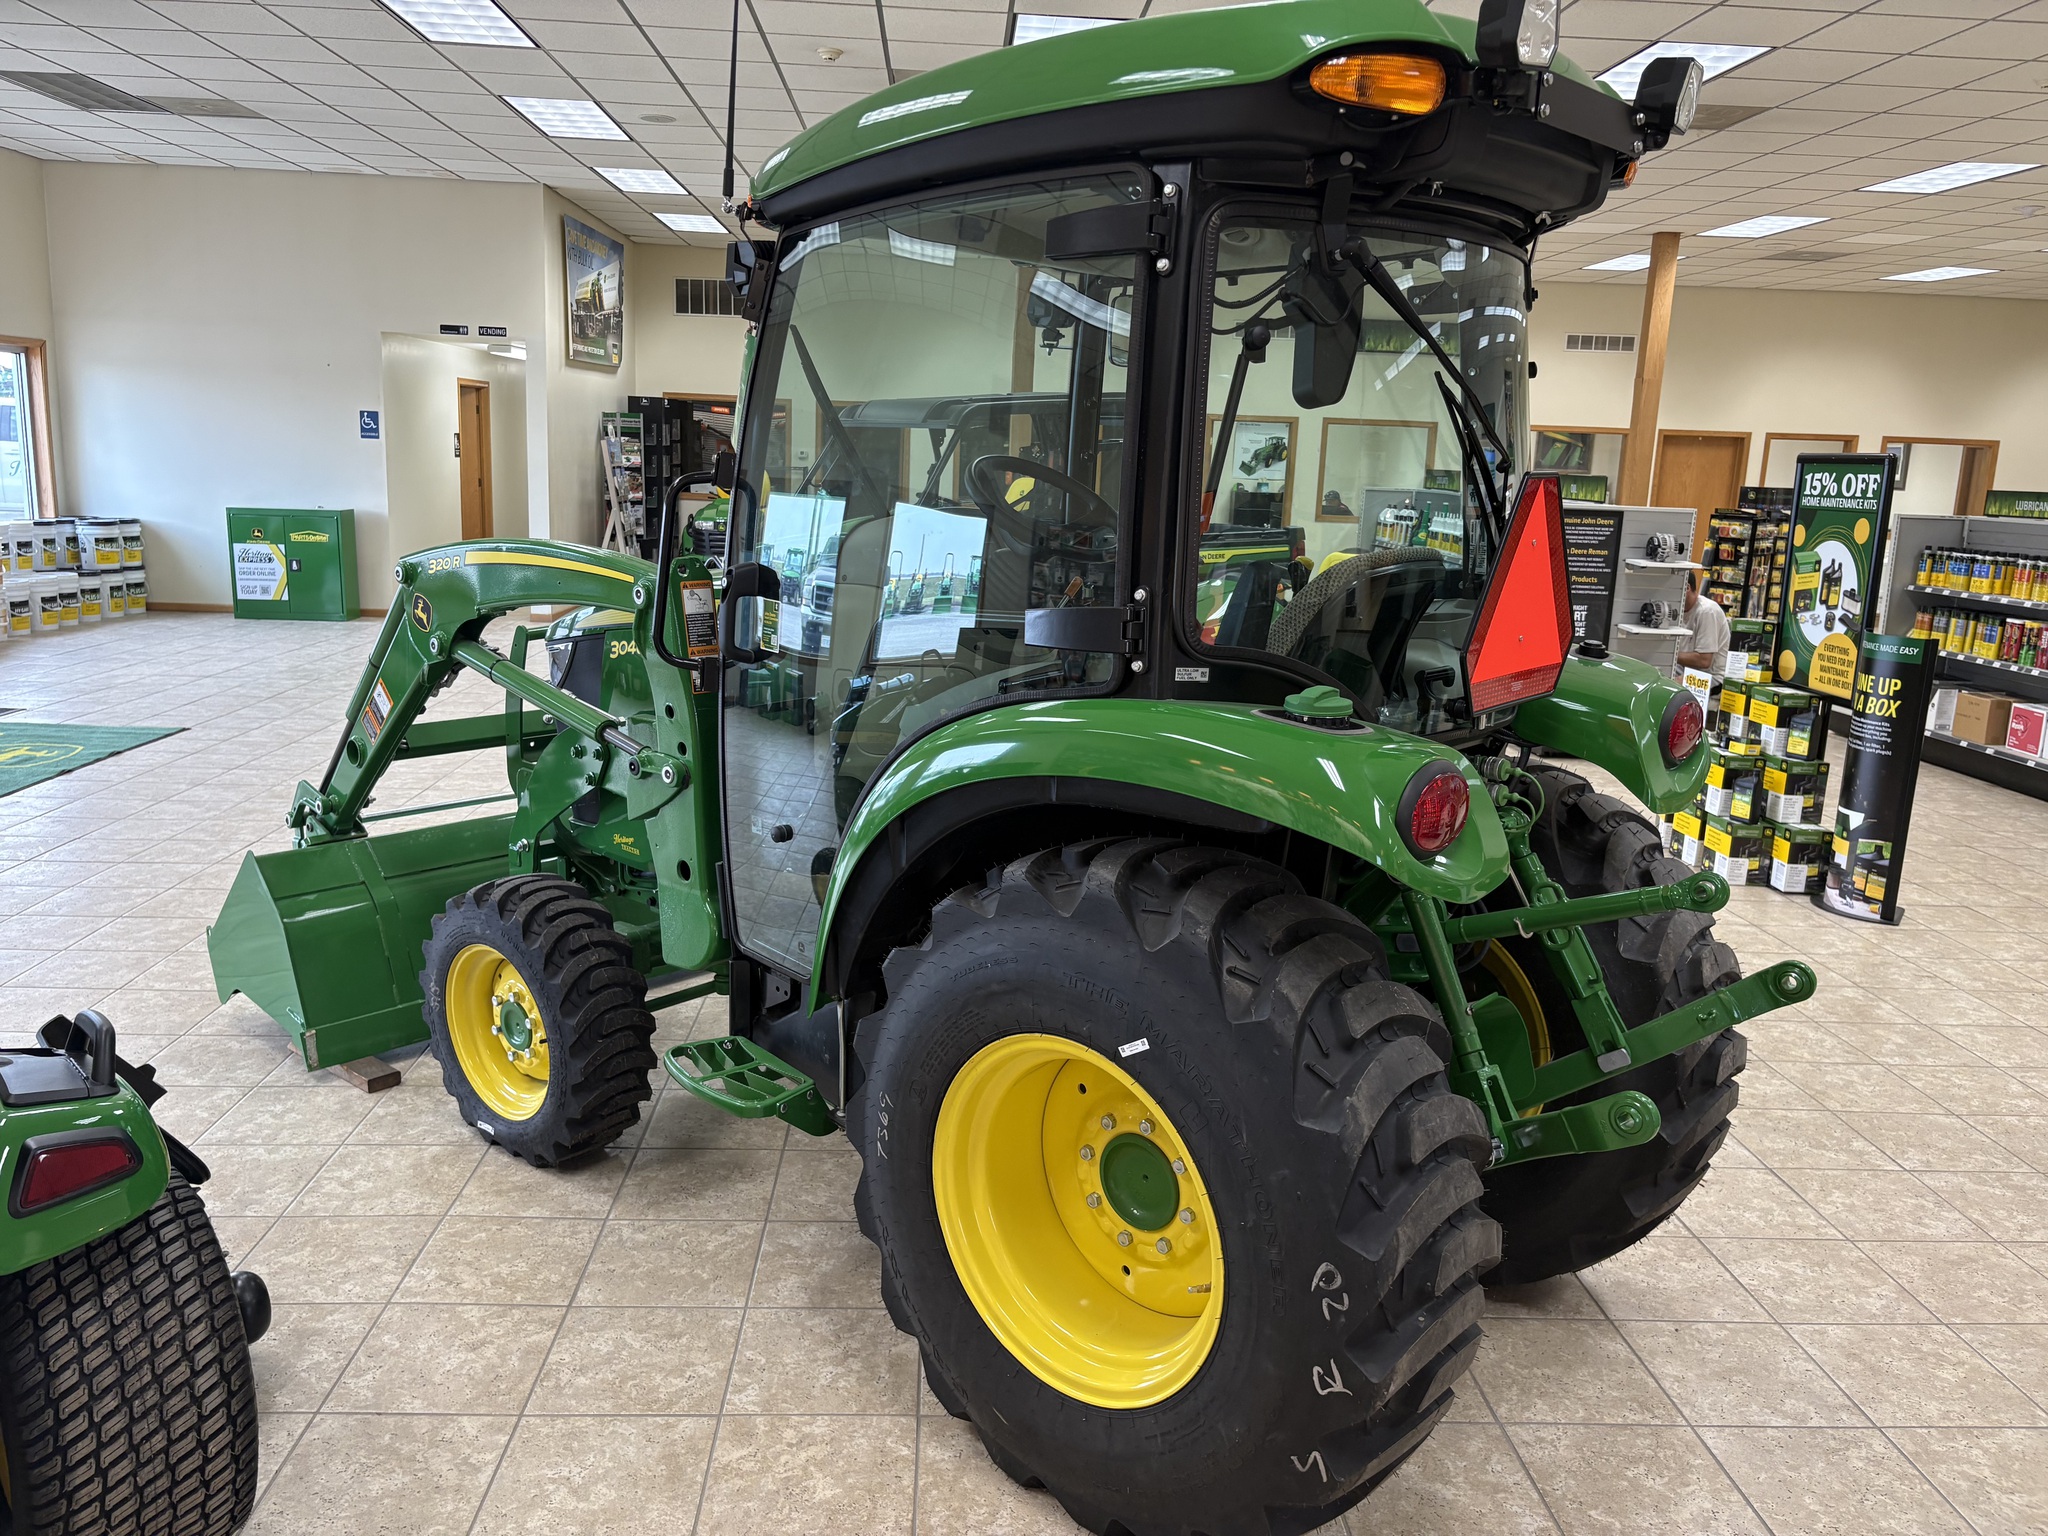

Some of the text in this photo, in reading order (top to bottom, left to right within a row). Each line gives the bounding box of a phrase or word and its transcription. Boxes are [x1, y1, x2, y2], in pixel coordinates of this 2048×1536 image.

[479, 327, 506, 336] VENDING
[1803, 472, 1881, 498] 15% OFF
[1801, 496, 1878, 510] HOME MAINTENANCE KITS
[238, 548, 274, 558] Heritage
[1570, 547, 1588, 555] Deere
[428, 556, 461, 575] 320 R
[1571, 575, 1598, 583] Products
[1574, 611, 1588, 621] RT
[1575, 627, 1586, 637] CE
[1823, 642, 1850, 657] EVERYTHING
[1880, 644, 1899, 654] MADE
[1899, 646, 1919, 656] EASY
[1817, 652, 1854, 669] YOU NEED FOR DIY
[1819, 663, 1850, 680] MAINTENANCE
[1685, 674, 1709, 690] 15% OFF
[1818, 677, 1852, 691] ALL IN ONE BOX!
[1877, 676, 1902, 697] UP
[1865, 696, 1902, 719] BOX
[950, 955, 1019, 983] TUBELESS
[1062, 971, 1287, 1315] THE MARATHONER
